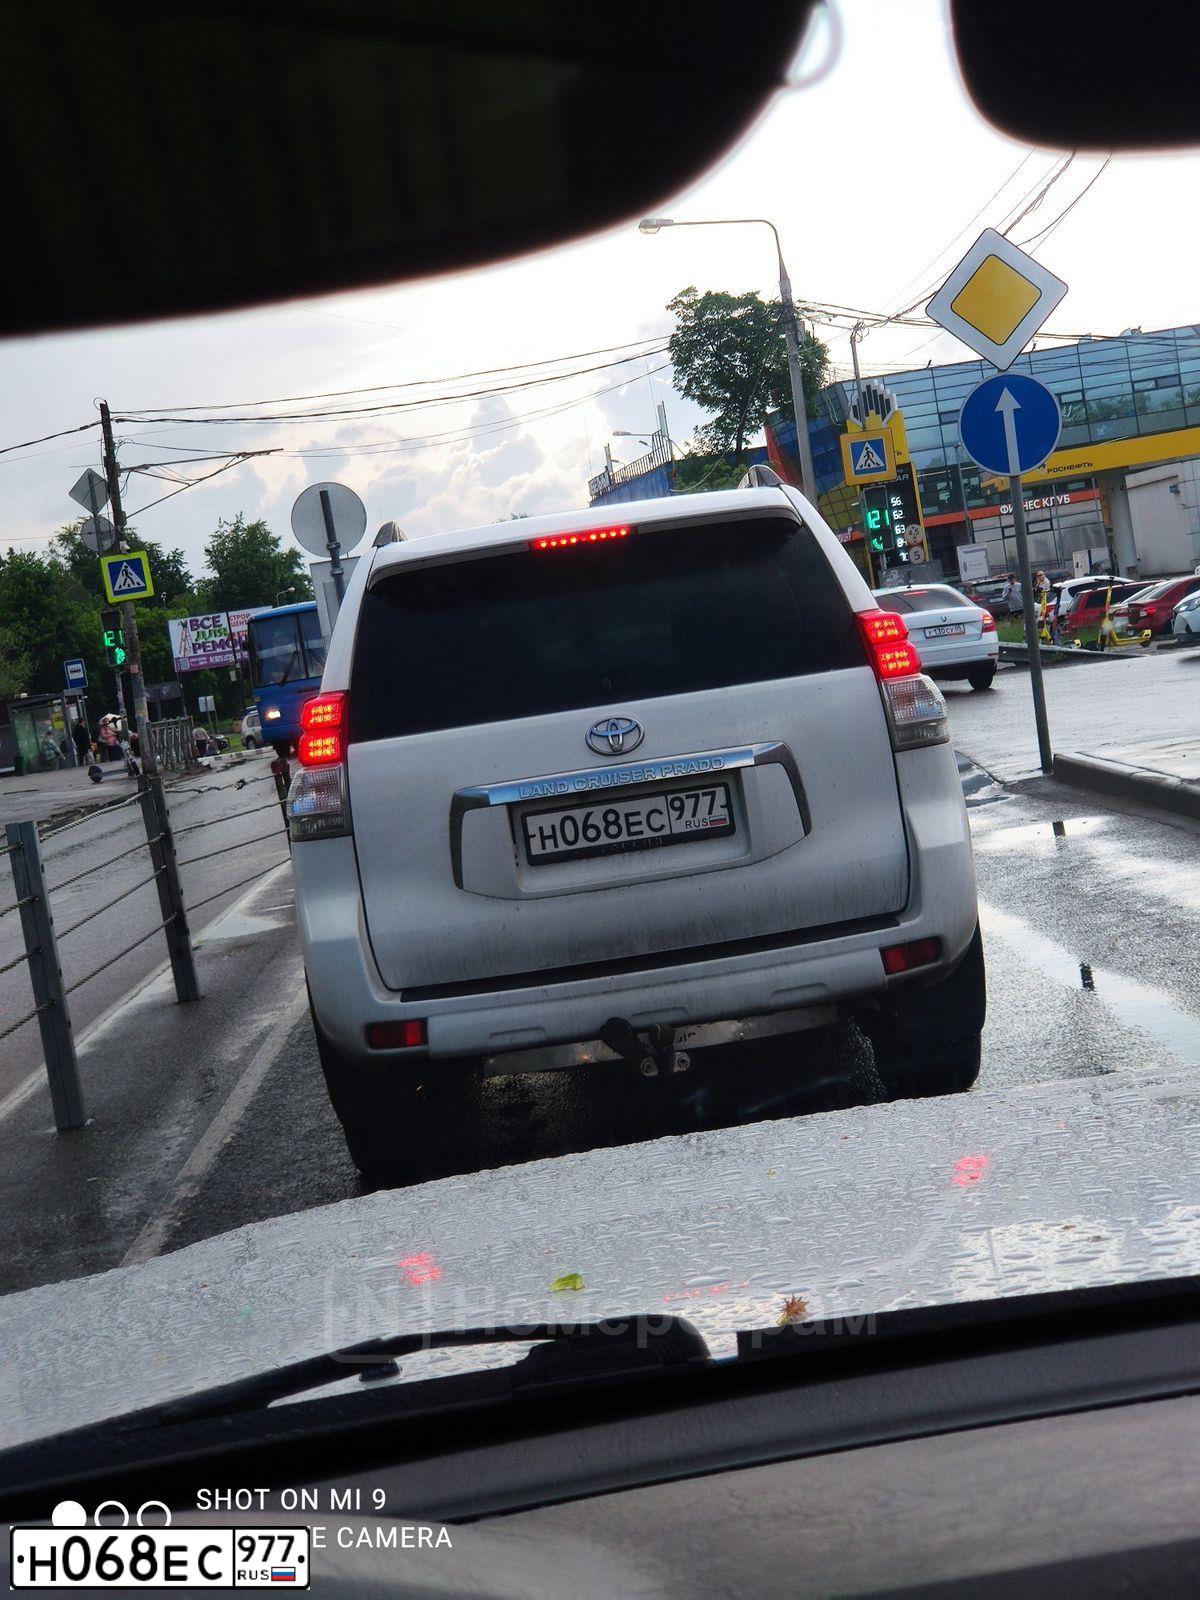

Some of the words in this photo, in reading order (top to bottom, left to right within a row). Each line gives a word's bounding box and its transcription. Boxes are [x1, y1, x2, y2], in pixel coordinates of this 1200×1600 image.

[1047, 462, 1093, 474] РОСНЕФТЬ
[1000, 499, 1040, 515] ФИНЕС
[189, 614, 223, 632] ВСЕ
[518, 781, 569, 800] LAND
[572, 767, 657, 792] CRUISER
[661, 756, 725, 777] PRADO
[538, 808, 666, 850] Н068ЕС
[669, 790, 717, 821] 977
[685, 817, 709, 829] RUS
